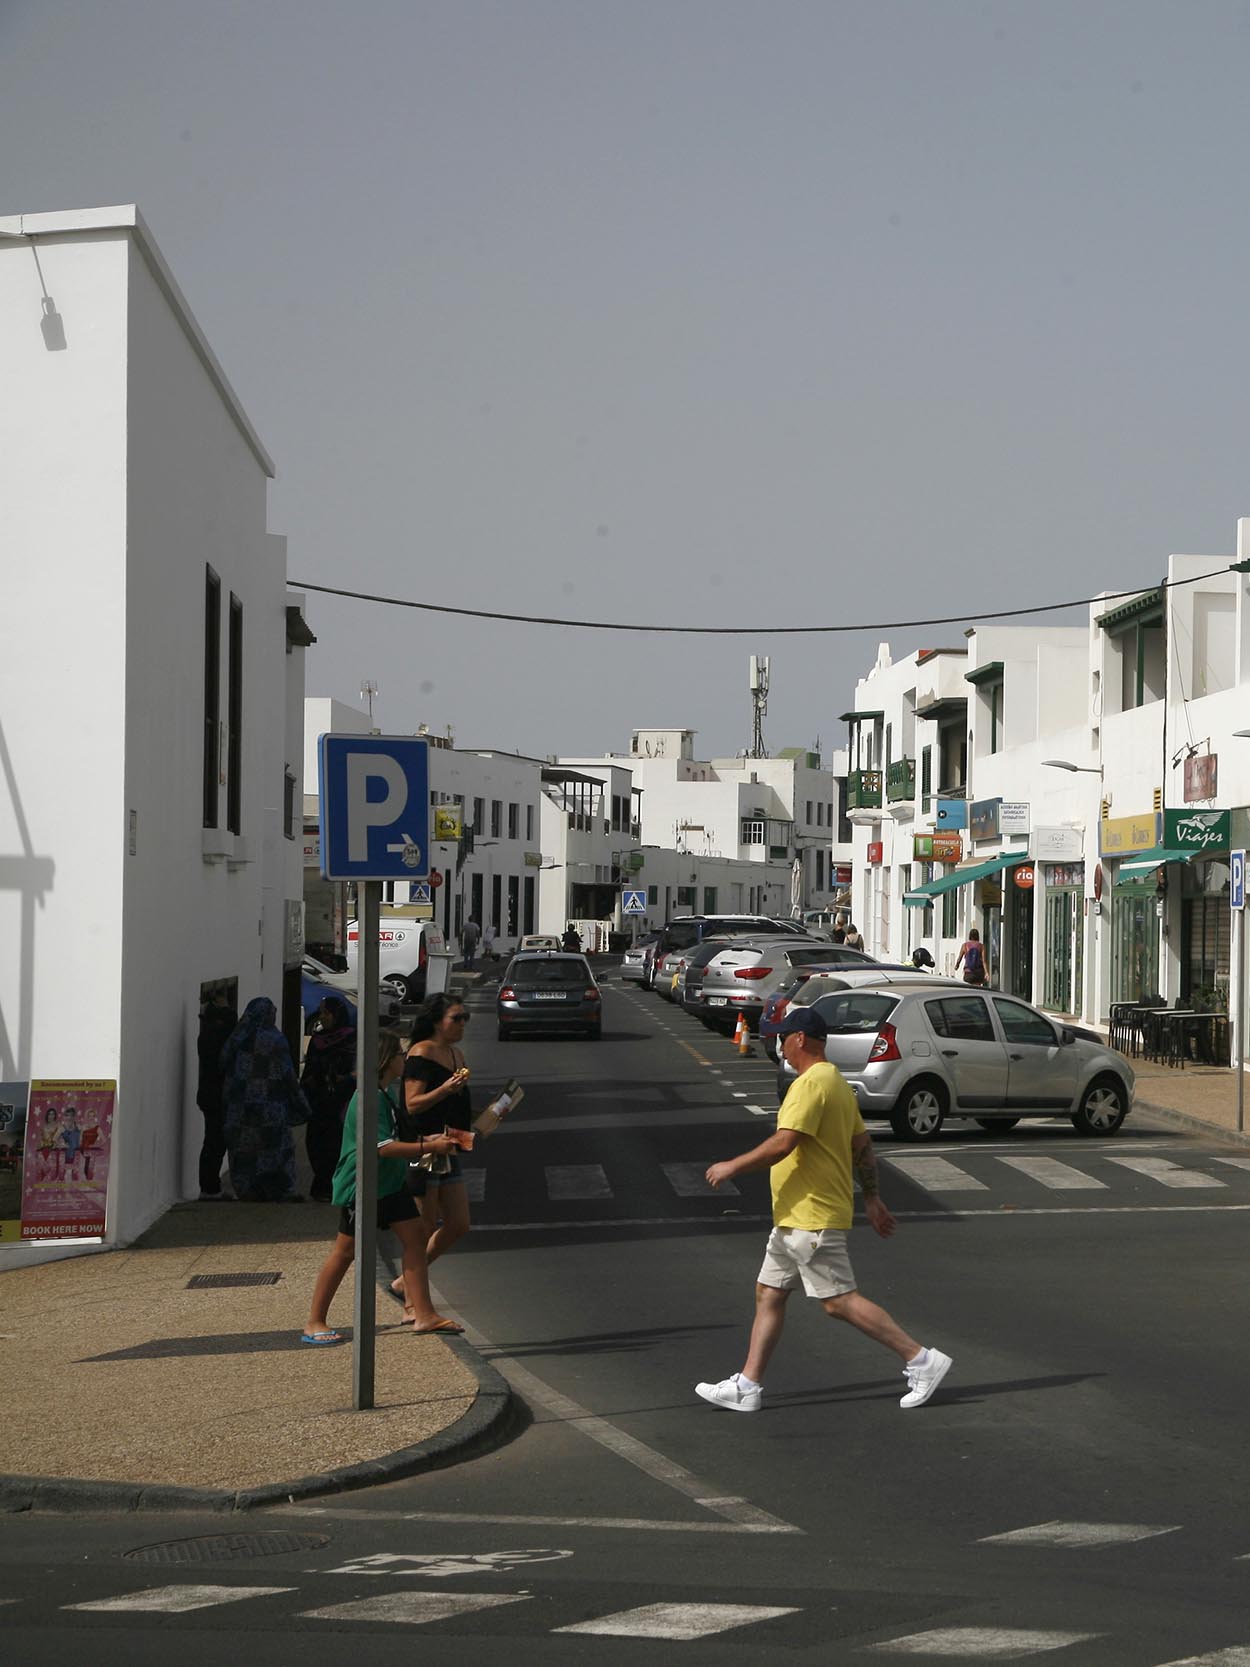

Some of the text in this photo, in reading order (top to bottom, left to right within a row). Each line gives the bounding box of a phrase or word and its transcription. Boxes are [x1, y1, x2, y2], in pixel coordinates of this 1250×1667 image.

[347, 753, 409, 862] P
[1176, 824, 1224, 848] Viajes
[1016, 868, 1033, 880] ria
[23, 1224, 103, 1235] BOOK HERE NOW
